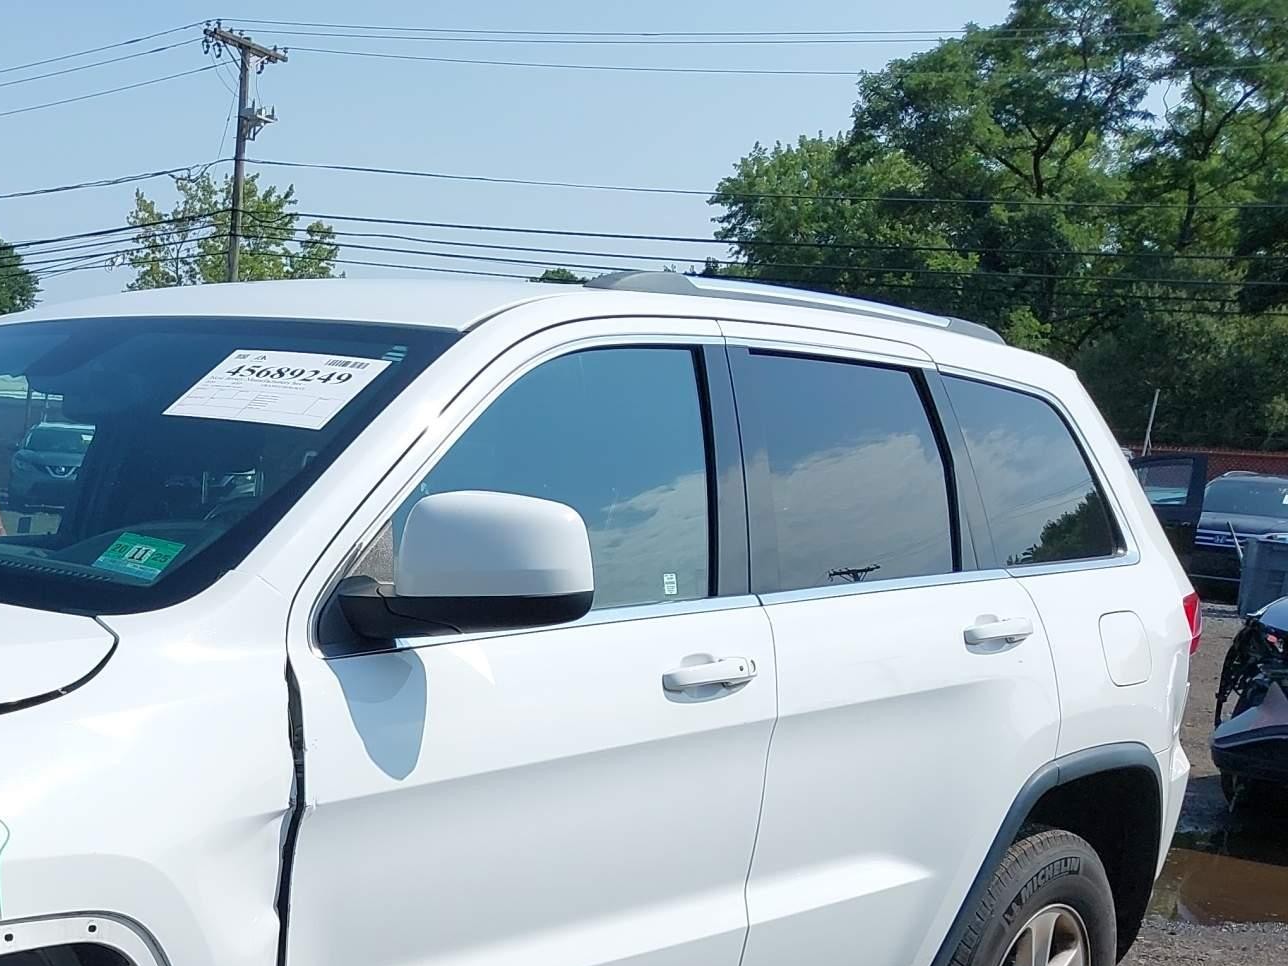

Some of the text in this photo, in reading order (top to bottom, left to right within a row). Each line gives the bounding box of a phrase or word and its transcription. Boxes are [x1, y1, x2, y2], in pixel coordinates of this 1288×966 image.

[226, 363, 353, 385] 45689249
[128, 547, 150, 561] 11
[152, 552, 169, 562] 25
[1020, 856, 1081, 905] MICHELIN
